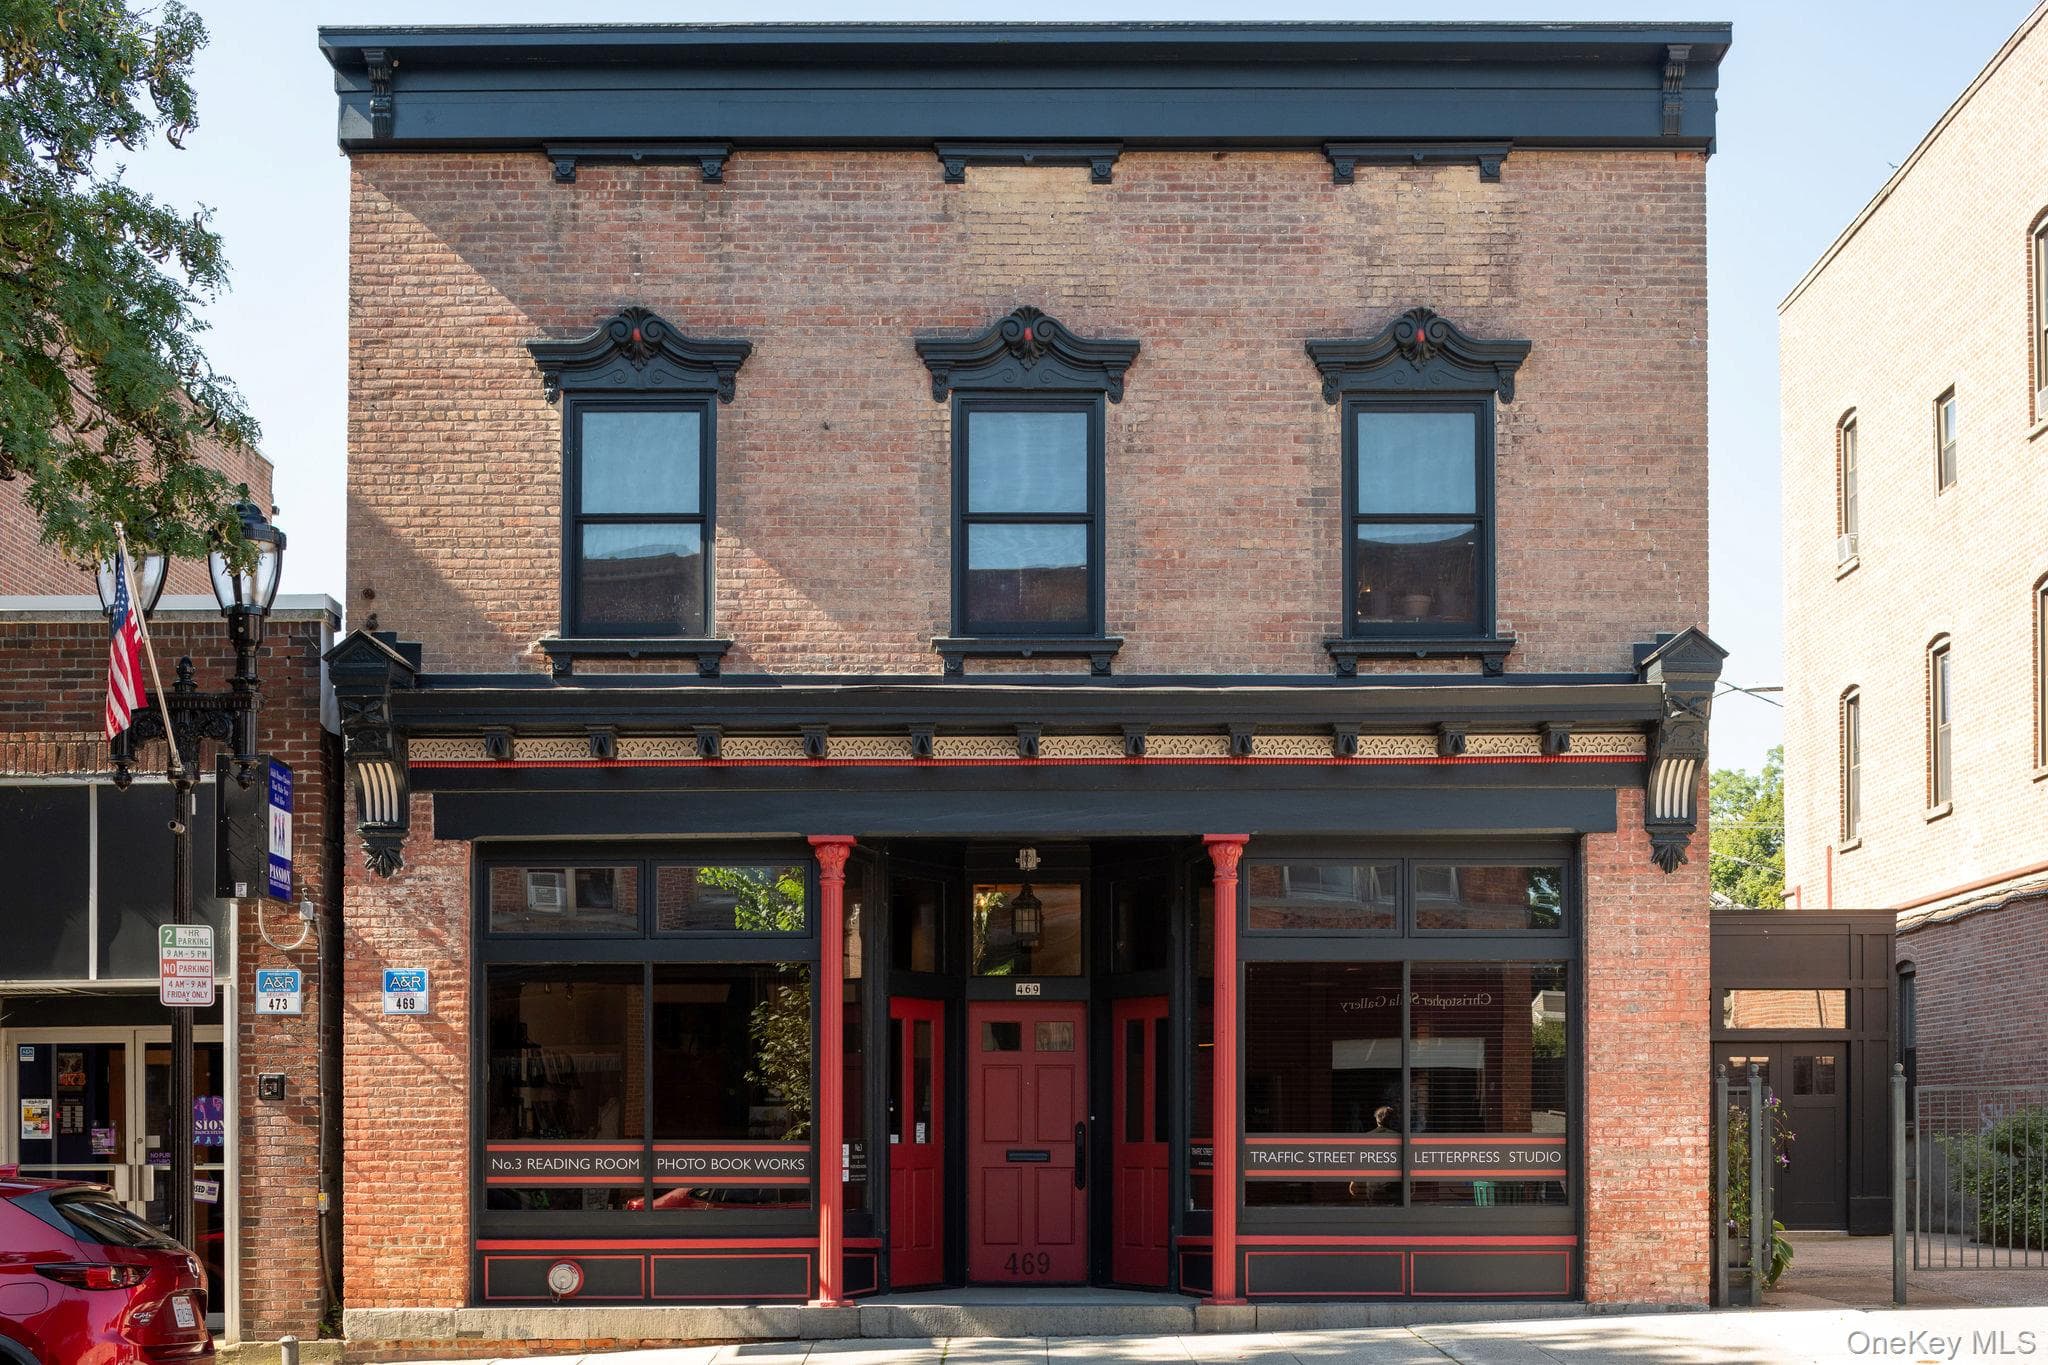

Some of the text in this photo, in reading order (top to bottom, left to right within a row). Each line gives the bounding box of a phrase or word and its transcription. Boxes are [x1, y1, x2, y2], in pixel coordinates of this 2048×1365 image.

[164, 930, 173, 944] 2
[191, 950, 195, 958] 5
[164, 963, 209, 974] NO PARKING
[263, 976, 294, 988] A&R
[390, 976, 421, 988] A&R
[1017, 985, 1038, 994] 469
[269, 999, 288, 1010] 473
[396, 998, 415, 1009] 469
[195, 1120, 224, 1130] SION
[1250, 1151, 1397, 1163] TRAFFIC STREET PRESS
[1414, 1151, 1561, 1163] LETTERPRESS STUDIO
[492, 1158, 640, 1170] No.3 READING ROOM
[657, 1158, 805, 1170] PHOTO BOOK WORKS
[1004, 1252, 1050, 1275] 469
